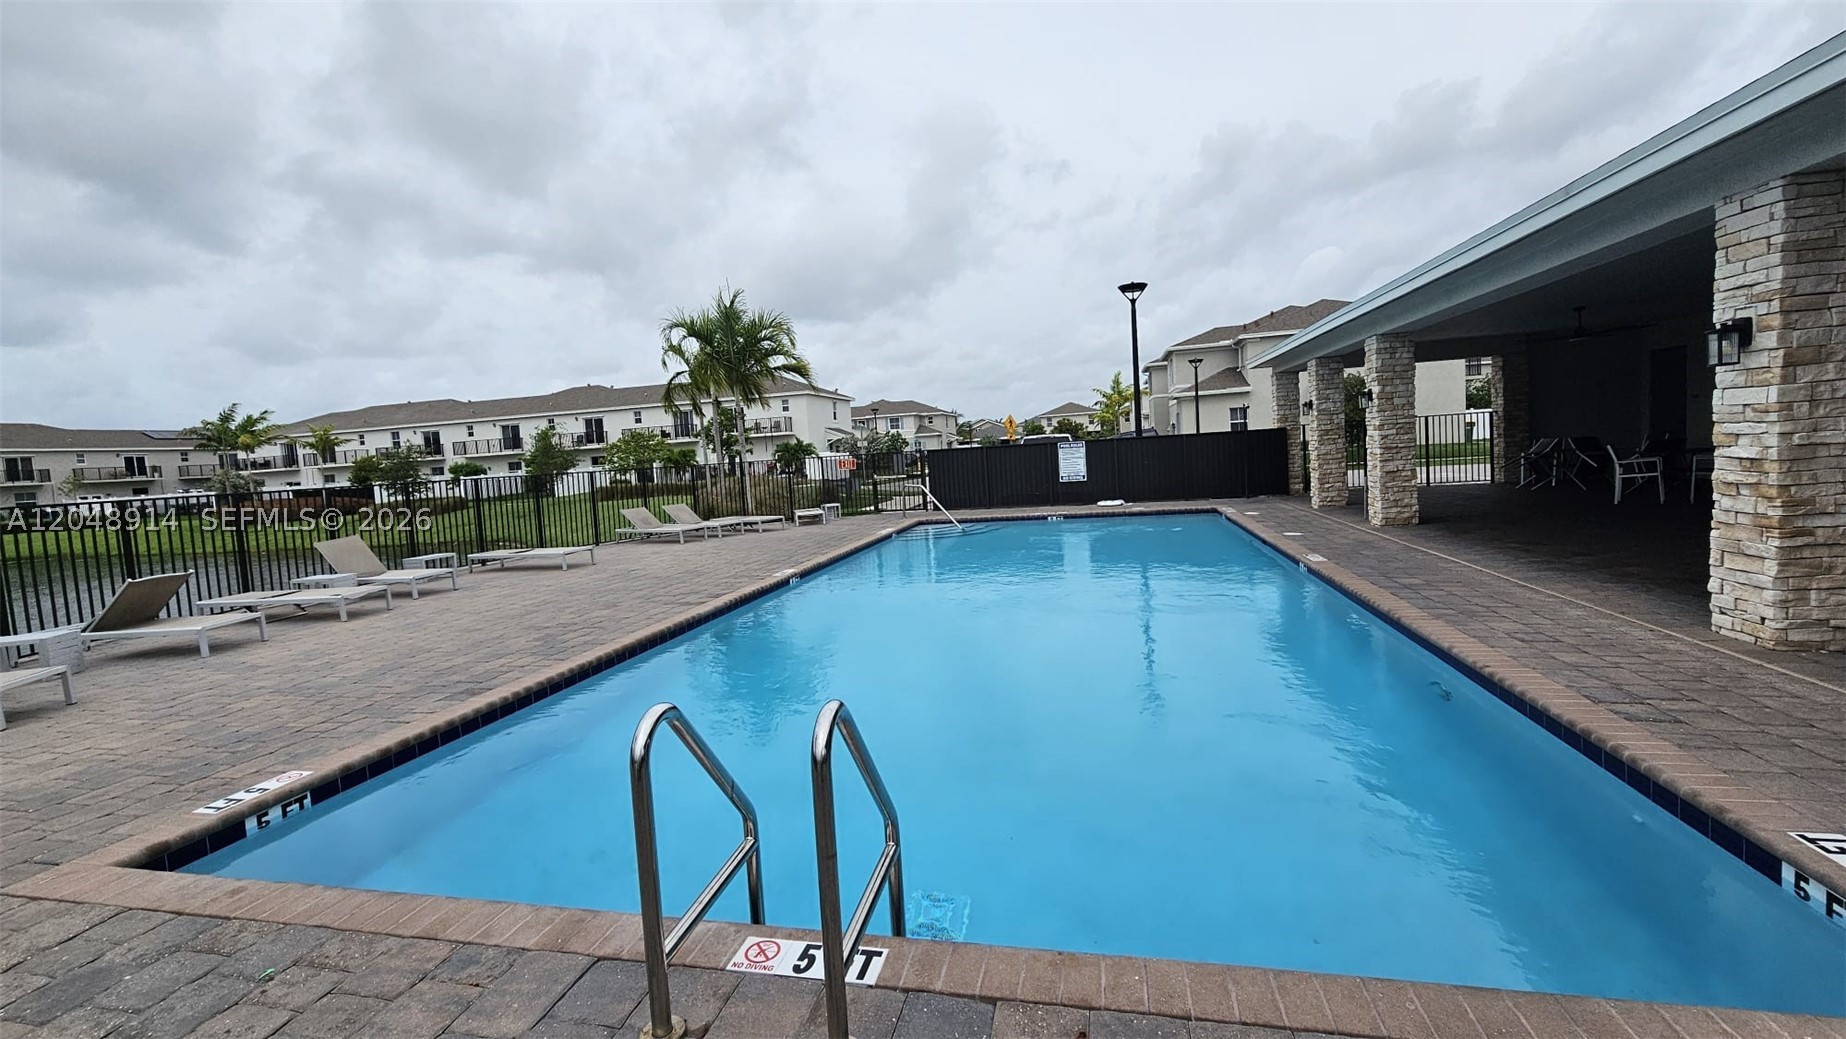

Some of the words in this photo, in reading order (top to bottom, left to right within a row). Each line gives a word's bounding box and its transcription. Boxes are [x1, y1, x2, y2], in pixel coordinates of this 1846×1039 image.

[244, 787, 271, 795] 5
[203, 798, 246, 812] FT
[256, 810, 271, 830] 5
[280, 793, 309, 820] FT
[1794, 869, 1811, 902] 5
[1825, 889, 1846, 920] F
[730, 961, 744, 969] NO
[744, 963, 775, 973] DIVING
[792, 943, 823, 975] 5
[848, 948, 884, 981] T
